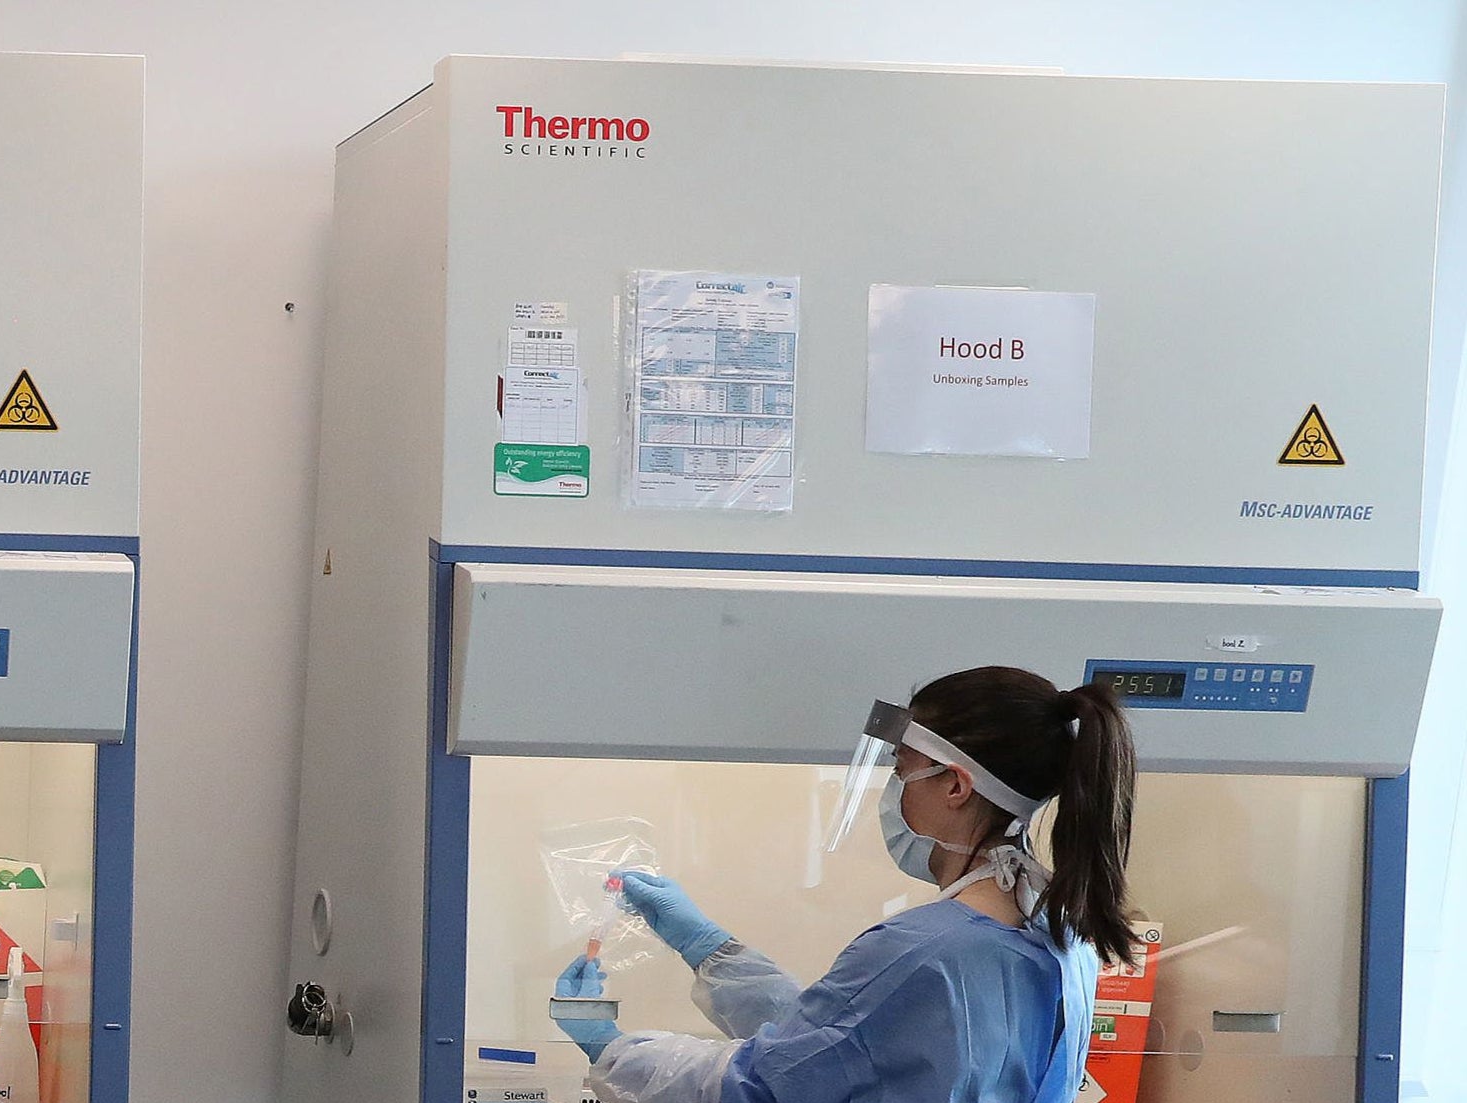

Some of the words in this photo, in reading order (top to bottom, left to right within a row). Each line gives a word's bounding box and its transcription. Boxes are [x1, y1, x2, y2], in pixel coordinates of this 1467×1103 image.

[496, 106, 650, 141] Thermo
[504, 143, 646, 158] SCIENTIFIC
[940, 337, 1002, 359] Hood
[1011, 339, 1025, 360] B
[932, 373, 983, 387] Unboxing
[985, 375, 1029, 387] Samples
[1240, 501, 1373, 521] MSC-ADVANTAGE
[504, 1091, 545, 1100] Stewart
